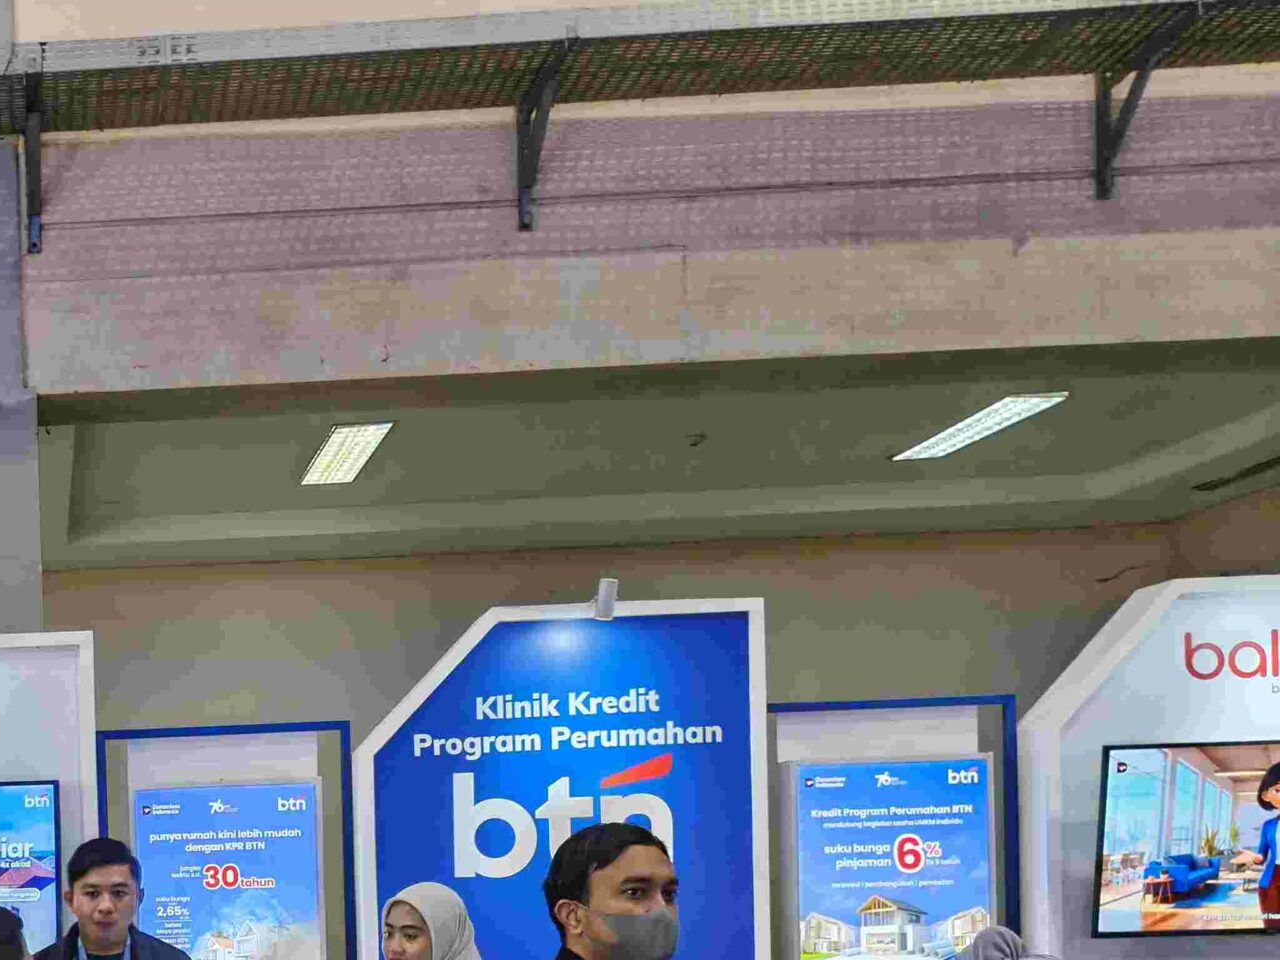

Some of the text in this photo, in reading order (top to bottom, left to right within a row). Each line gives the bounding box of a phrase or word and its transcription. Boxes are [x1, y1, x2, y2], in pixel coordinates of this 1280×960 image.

[475, 688, 660, 720] Klinik Kredit
[413, 721, 723, 761] Program Perumahan
[947, 767, 979, 785] btn
[25, 793, 50, 808] btn
[209, 799, 224, 814] 76
[277, 796, 306, 812] btn
[810, 804, 973, 819] Kredit Program Perumahan BTN
[149, 828, 302, 844] punya rumah kini lebih mudah
[185, 841, 265, 854] dengan KPR BTN
[823, 843, 890, 855] suku bunga
[836, 857, 892, 870] pinjaman
[203, 863, 240, 890] 30
[240, 876, 276, 889] tahun
